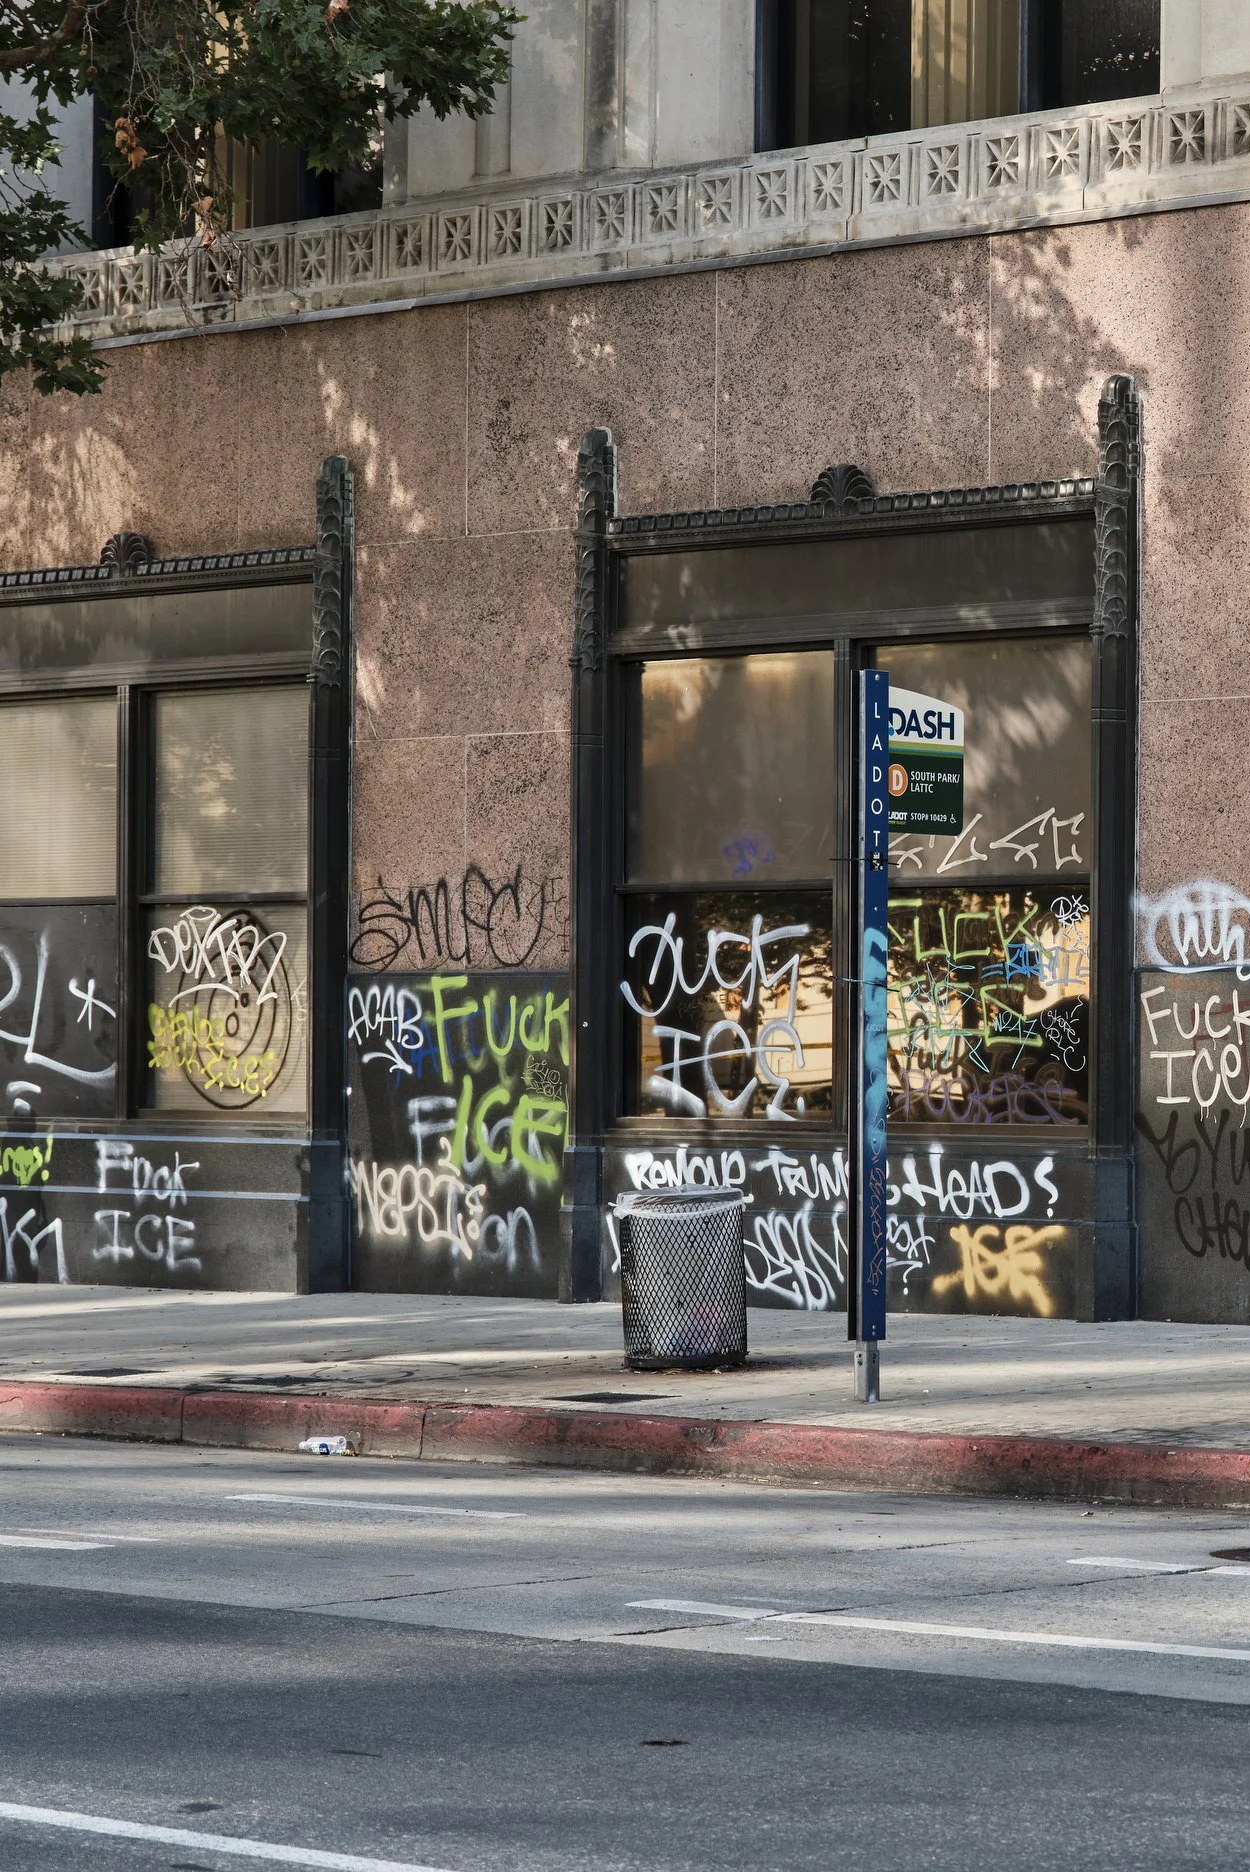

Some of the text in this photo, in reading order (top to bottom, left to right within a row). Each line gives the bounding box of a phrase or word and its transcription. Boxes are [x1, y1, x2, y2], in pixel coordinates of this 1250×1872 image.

[889, 708, 955, 741] DASH
[893, 770, 904, 791] D
[911, 771, 960, 783] SOUTH PARK/
[911, 784, 934, 793] LATTC
[452, 1074, 568, 1183] ICE
[93, 1208, 201, 1271] ICE
